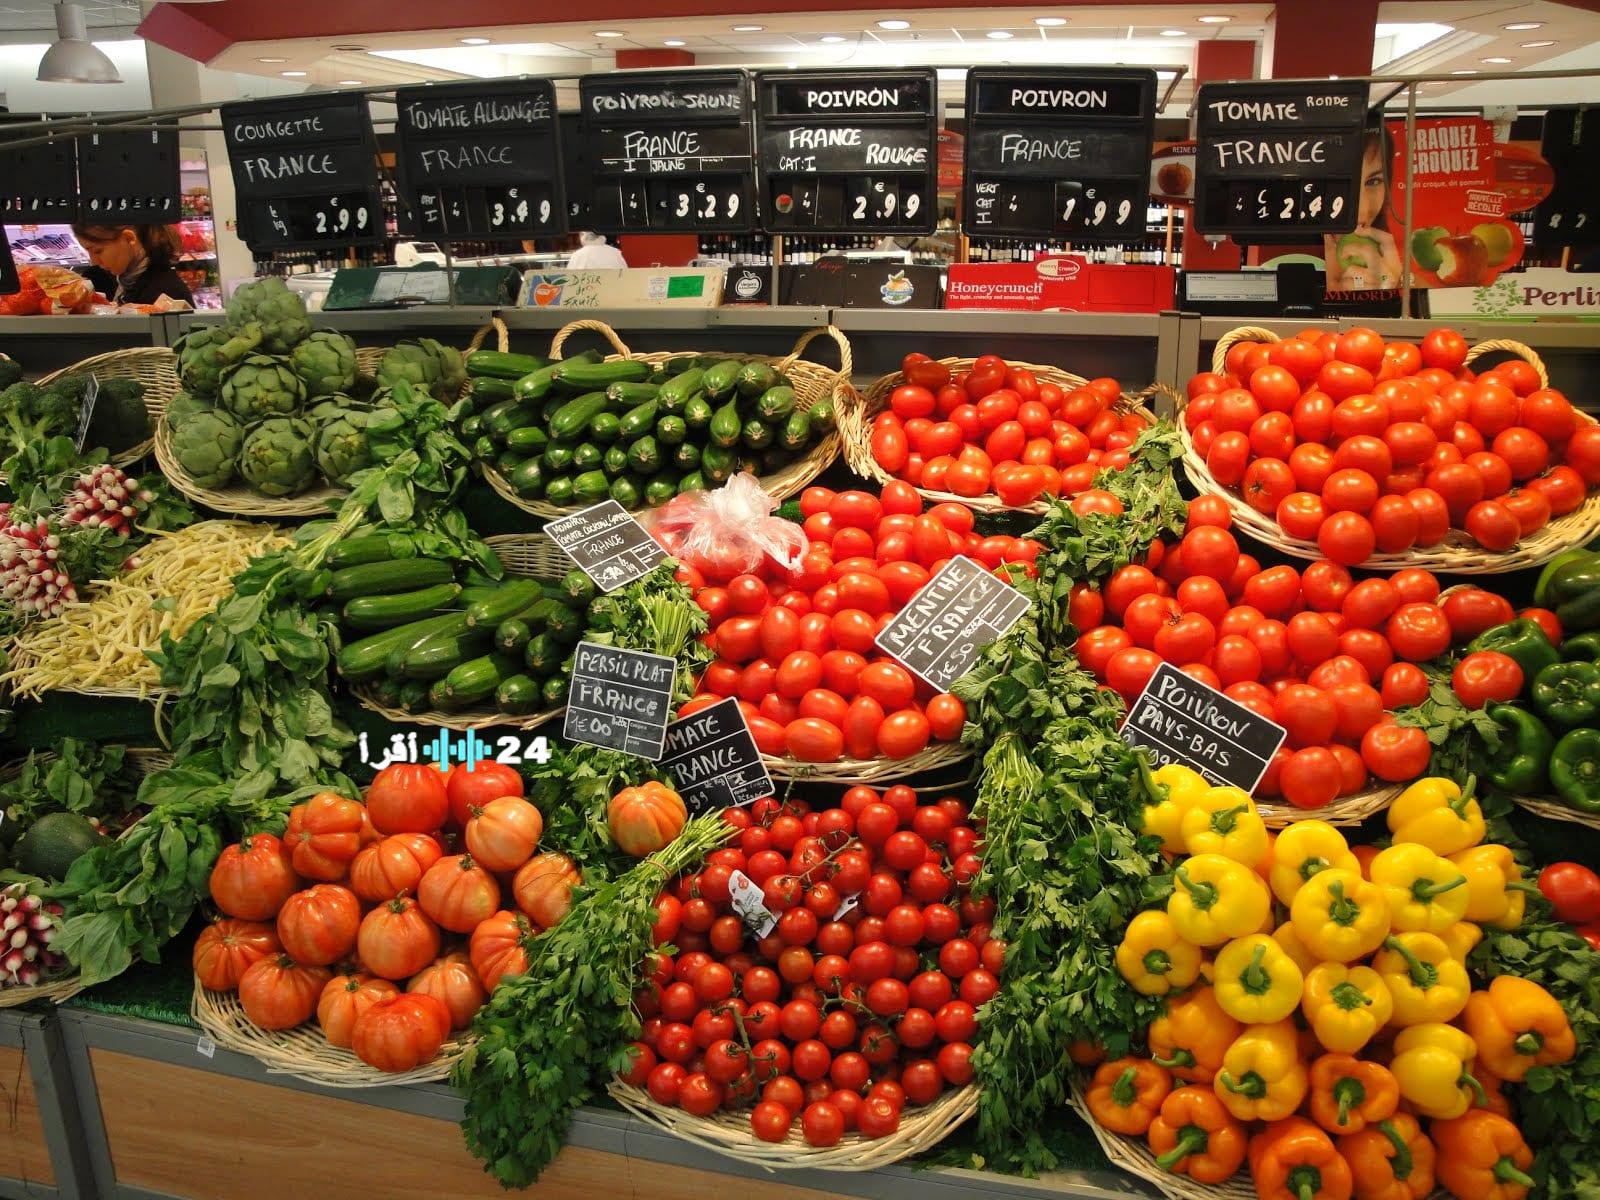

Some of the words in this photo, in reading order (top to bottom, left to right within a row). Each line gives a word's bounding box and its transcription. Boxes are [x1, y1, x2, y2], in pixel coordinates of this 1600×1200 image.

[593, 92, 675, 113] POIVRON
[682, 92, 742, 110] JAUNE
[808, 88, 899, 108] POIVRON
[1011, 88, 1107, 108] POIVRON
[1209, 100, 1299, 122] TOMATE
[1306, 96, 1349, 107] RONDE
[405, 101, 471, 130] TOMATE
[234, 116, 324, 142] COURGETTE
[789, 126, 863, 149] FRANCE
[624, 130, 700, 159] FRANCE
[865, 143, 928, 165] ROUGE
[1001, 133, 1082, 163] FRANCE
[1213, 140, 1326, 168] FRANCE
[243, 154, 337, 183] FRANCE
[421, 146, 513, 174] FRANCE
[651, 158, 686, 172] JAUNE
[508, 188, 518, 198] €
[696, 182, 706, 193] €
[874, 182, 885, 192] €
[975, 183, 999, 193] VERT
[1085, 188, 1096, 199] €
[1304, 183, 1313, 192] €
[330, 197, 338, 207] €
[676, 193, 740, 218] 3.29
[853, 193, 920, 219] 2.99
[975, 198, 996, 208] CAT
[1063, 197, 1131, 226] 1.99
[315, 206, 368, 234] 2.99
[582, 533, 625, 559] FRANCE
[889, 564, 967, 648] MENTHE
[917, 575, 993, 656] FRANCE
[579, 650, 630, 676] PERSIL
[634, 662, 673, 683] PLAT
[580, 684, 659, 717] FRANCE
[1158, 674, 1251, 738] POIVRON
[1138, 704, 1232, 767] PAYS-BAS
[669, 746, 743, 785] RANCE
